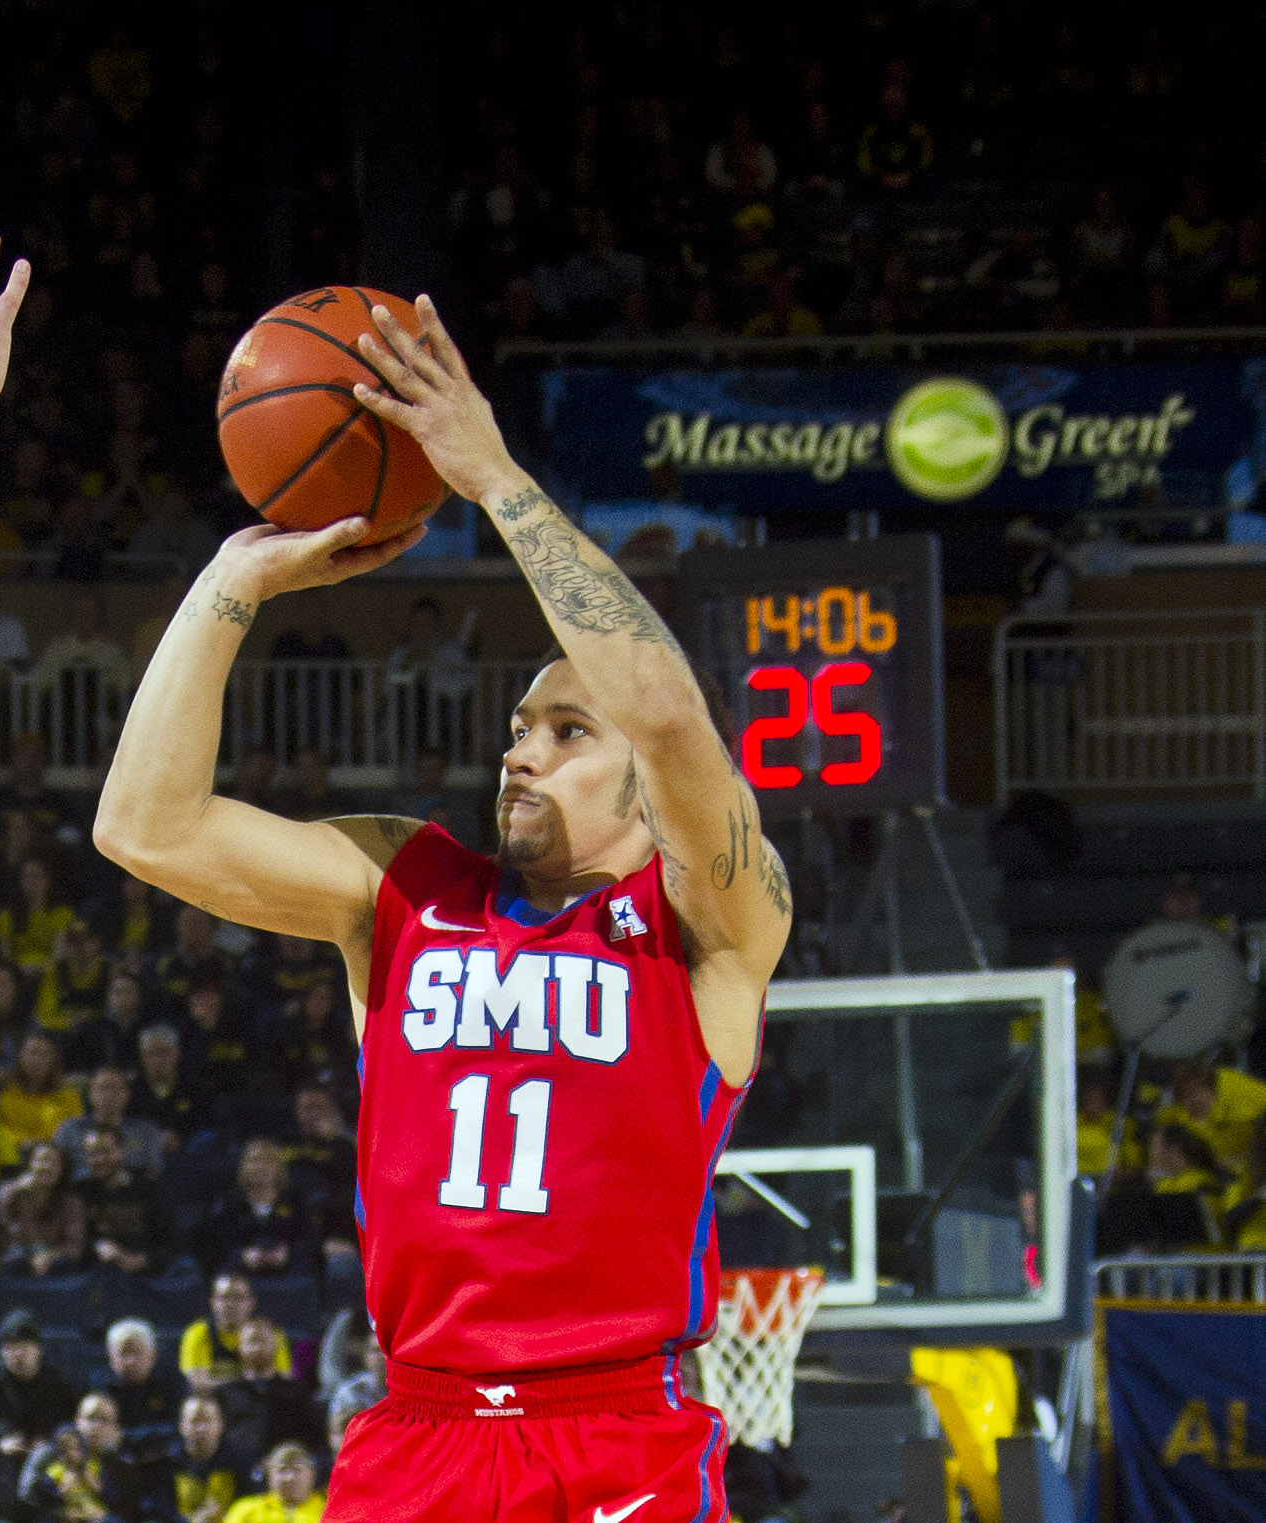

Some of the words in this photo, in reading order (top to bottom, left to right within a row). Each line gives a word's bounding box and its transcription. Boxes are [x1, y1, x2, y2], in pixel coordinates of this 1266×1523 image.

[643, 410, 880, 481] Massage
[1015, 392, 1194, 476] Green
[746, 586, 897, 655] 14:06
[742, 662, 882, 789] 25
[401, 946, 632, 1066] SMU
[438, 1073, 552, 1216] 11
